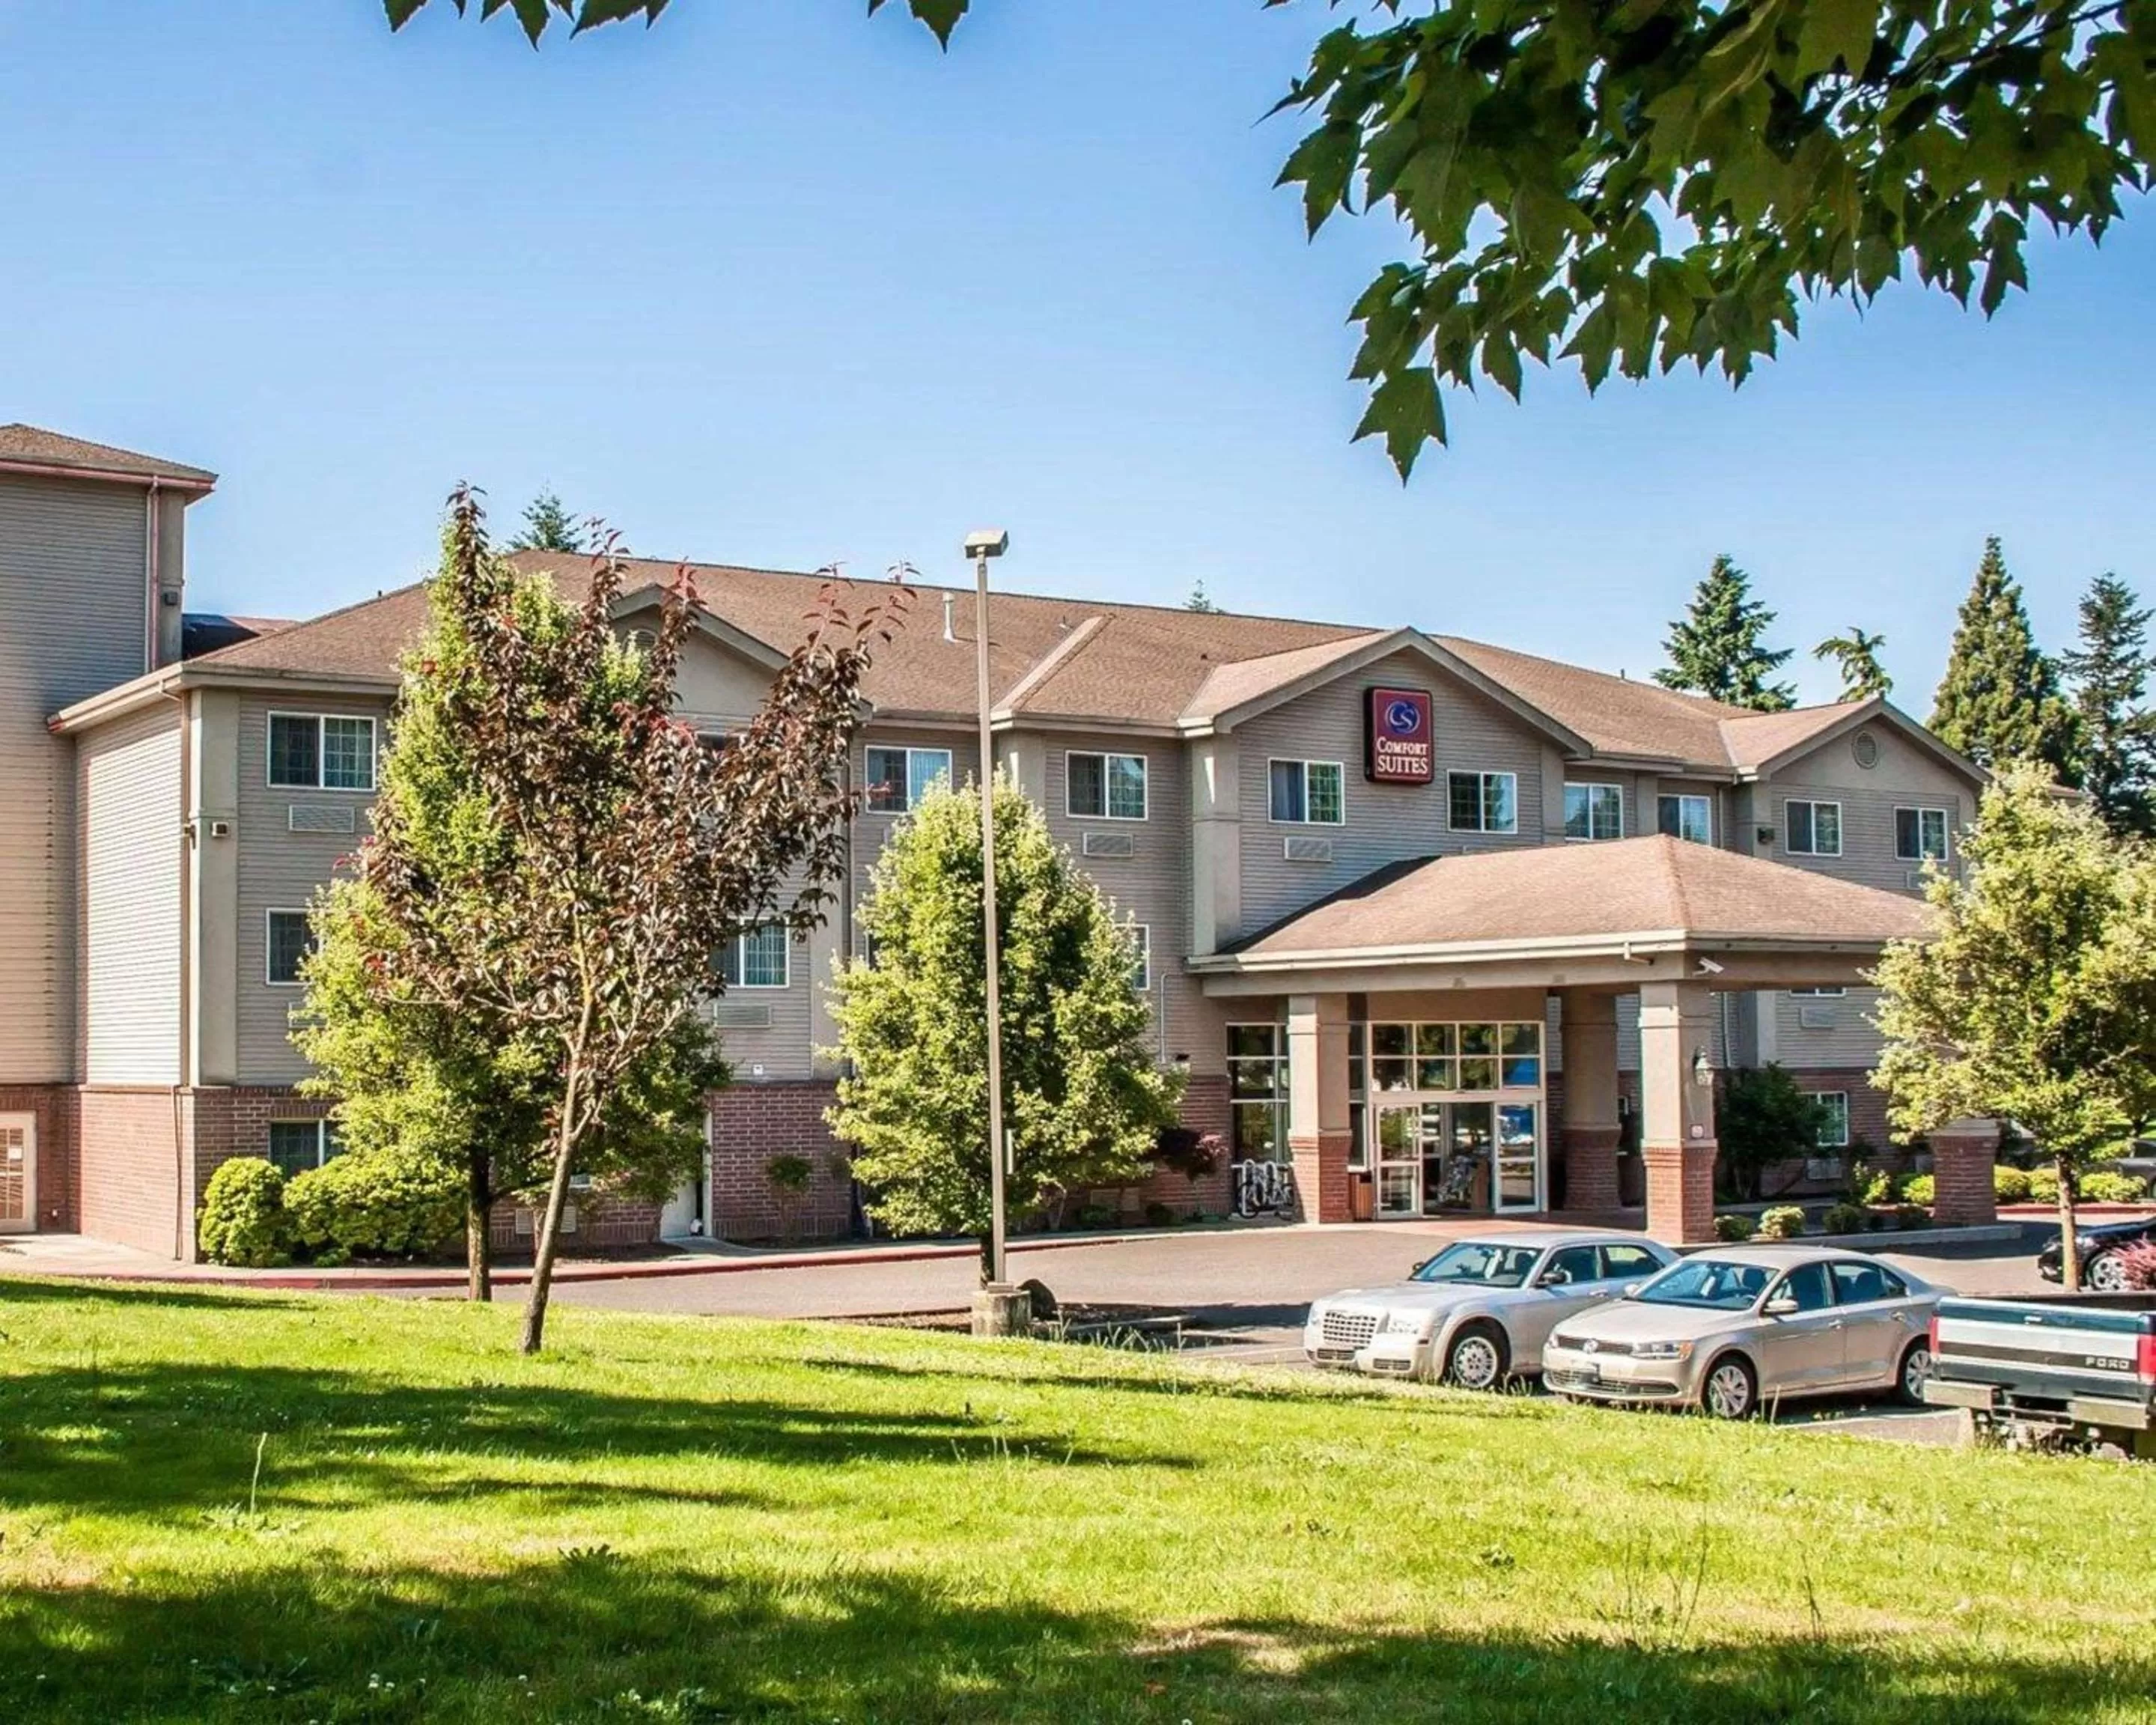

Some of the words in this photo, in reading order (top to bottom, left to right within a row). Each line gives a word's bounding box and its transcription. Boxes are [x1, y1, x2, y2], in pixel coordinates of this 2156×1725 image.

[1377, 736, 1428, 755] COMFORT
[1377, 755, 1428, 774] SUITES
[2085, 1356, 2130, 1370] FORD
